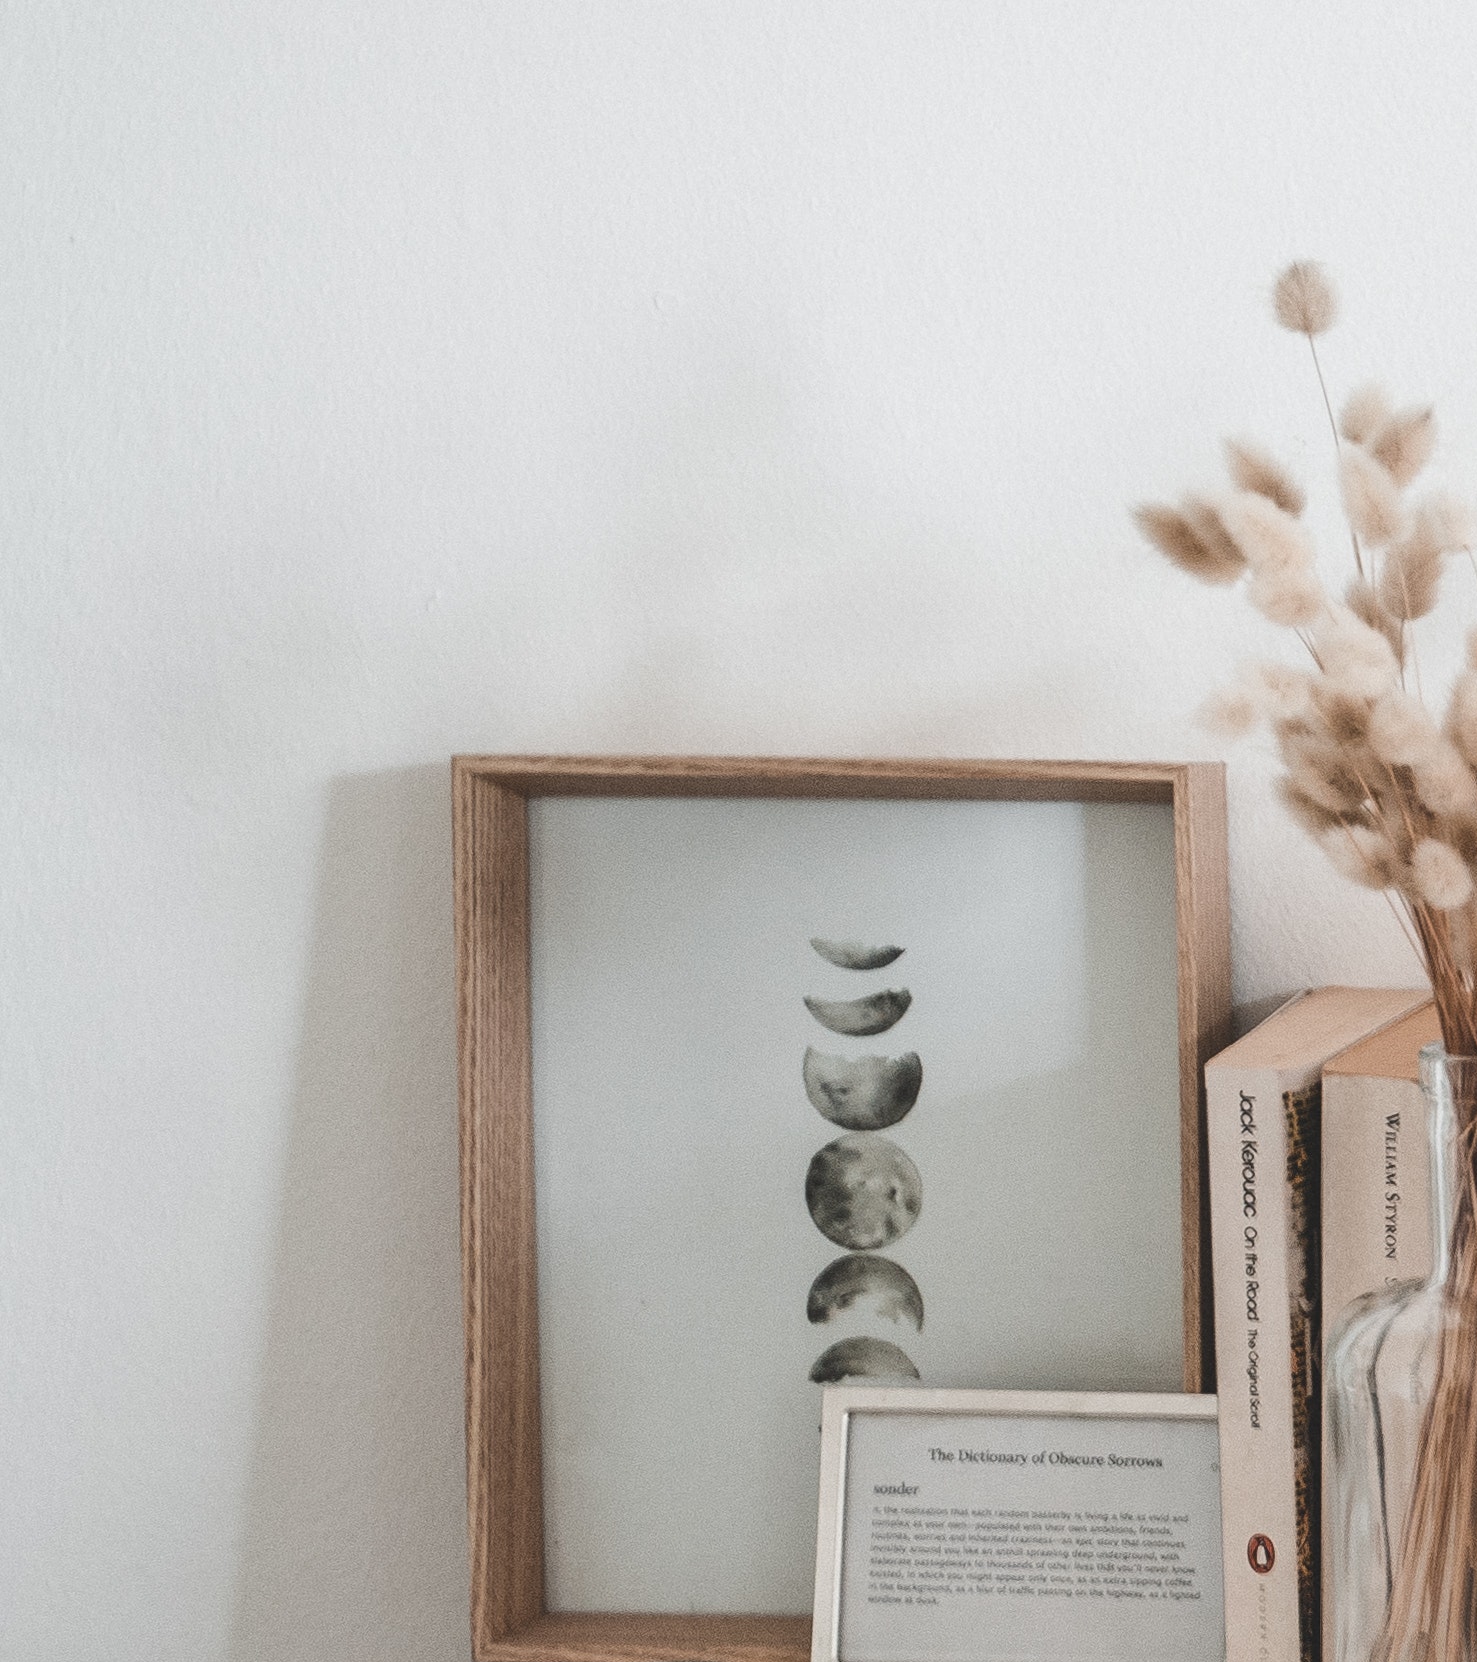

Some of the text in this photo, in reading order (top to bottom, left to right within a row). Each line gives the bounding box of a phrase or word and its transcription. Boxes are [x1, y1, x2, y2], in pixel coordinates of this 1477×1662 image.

[1239, 1090, 1261, 1429] Jack Kerouac On the Road The Original Scroll
[928, 1448, 1163, 1467] The Dictionary of Obscure Sorrows
[873, 1482, 919, 1495] sonder
[1259, 1583, 1269, 1640] MODERN
